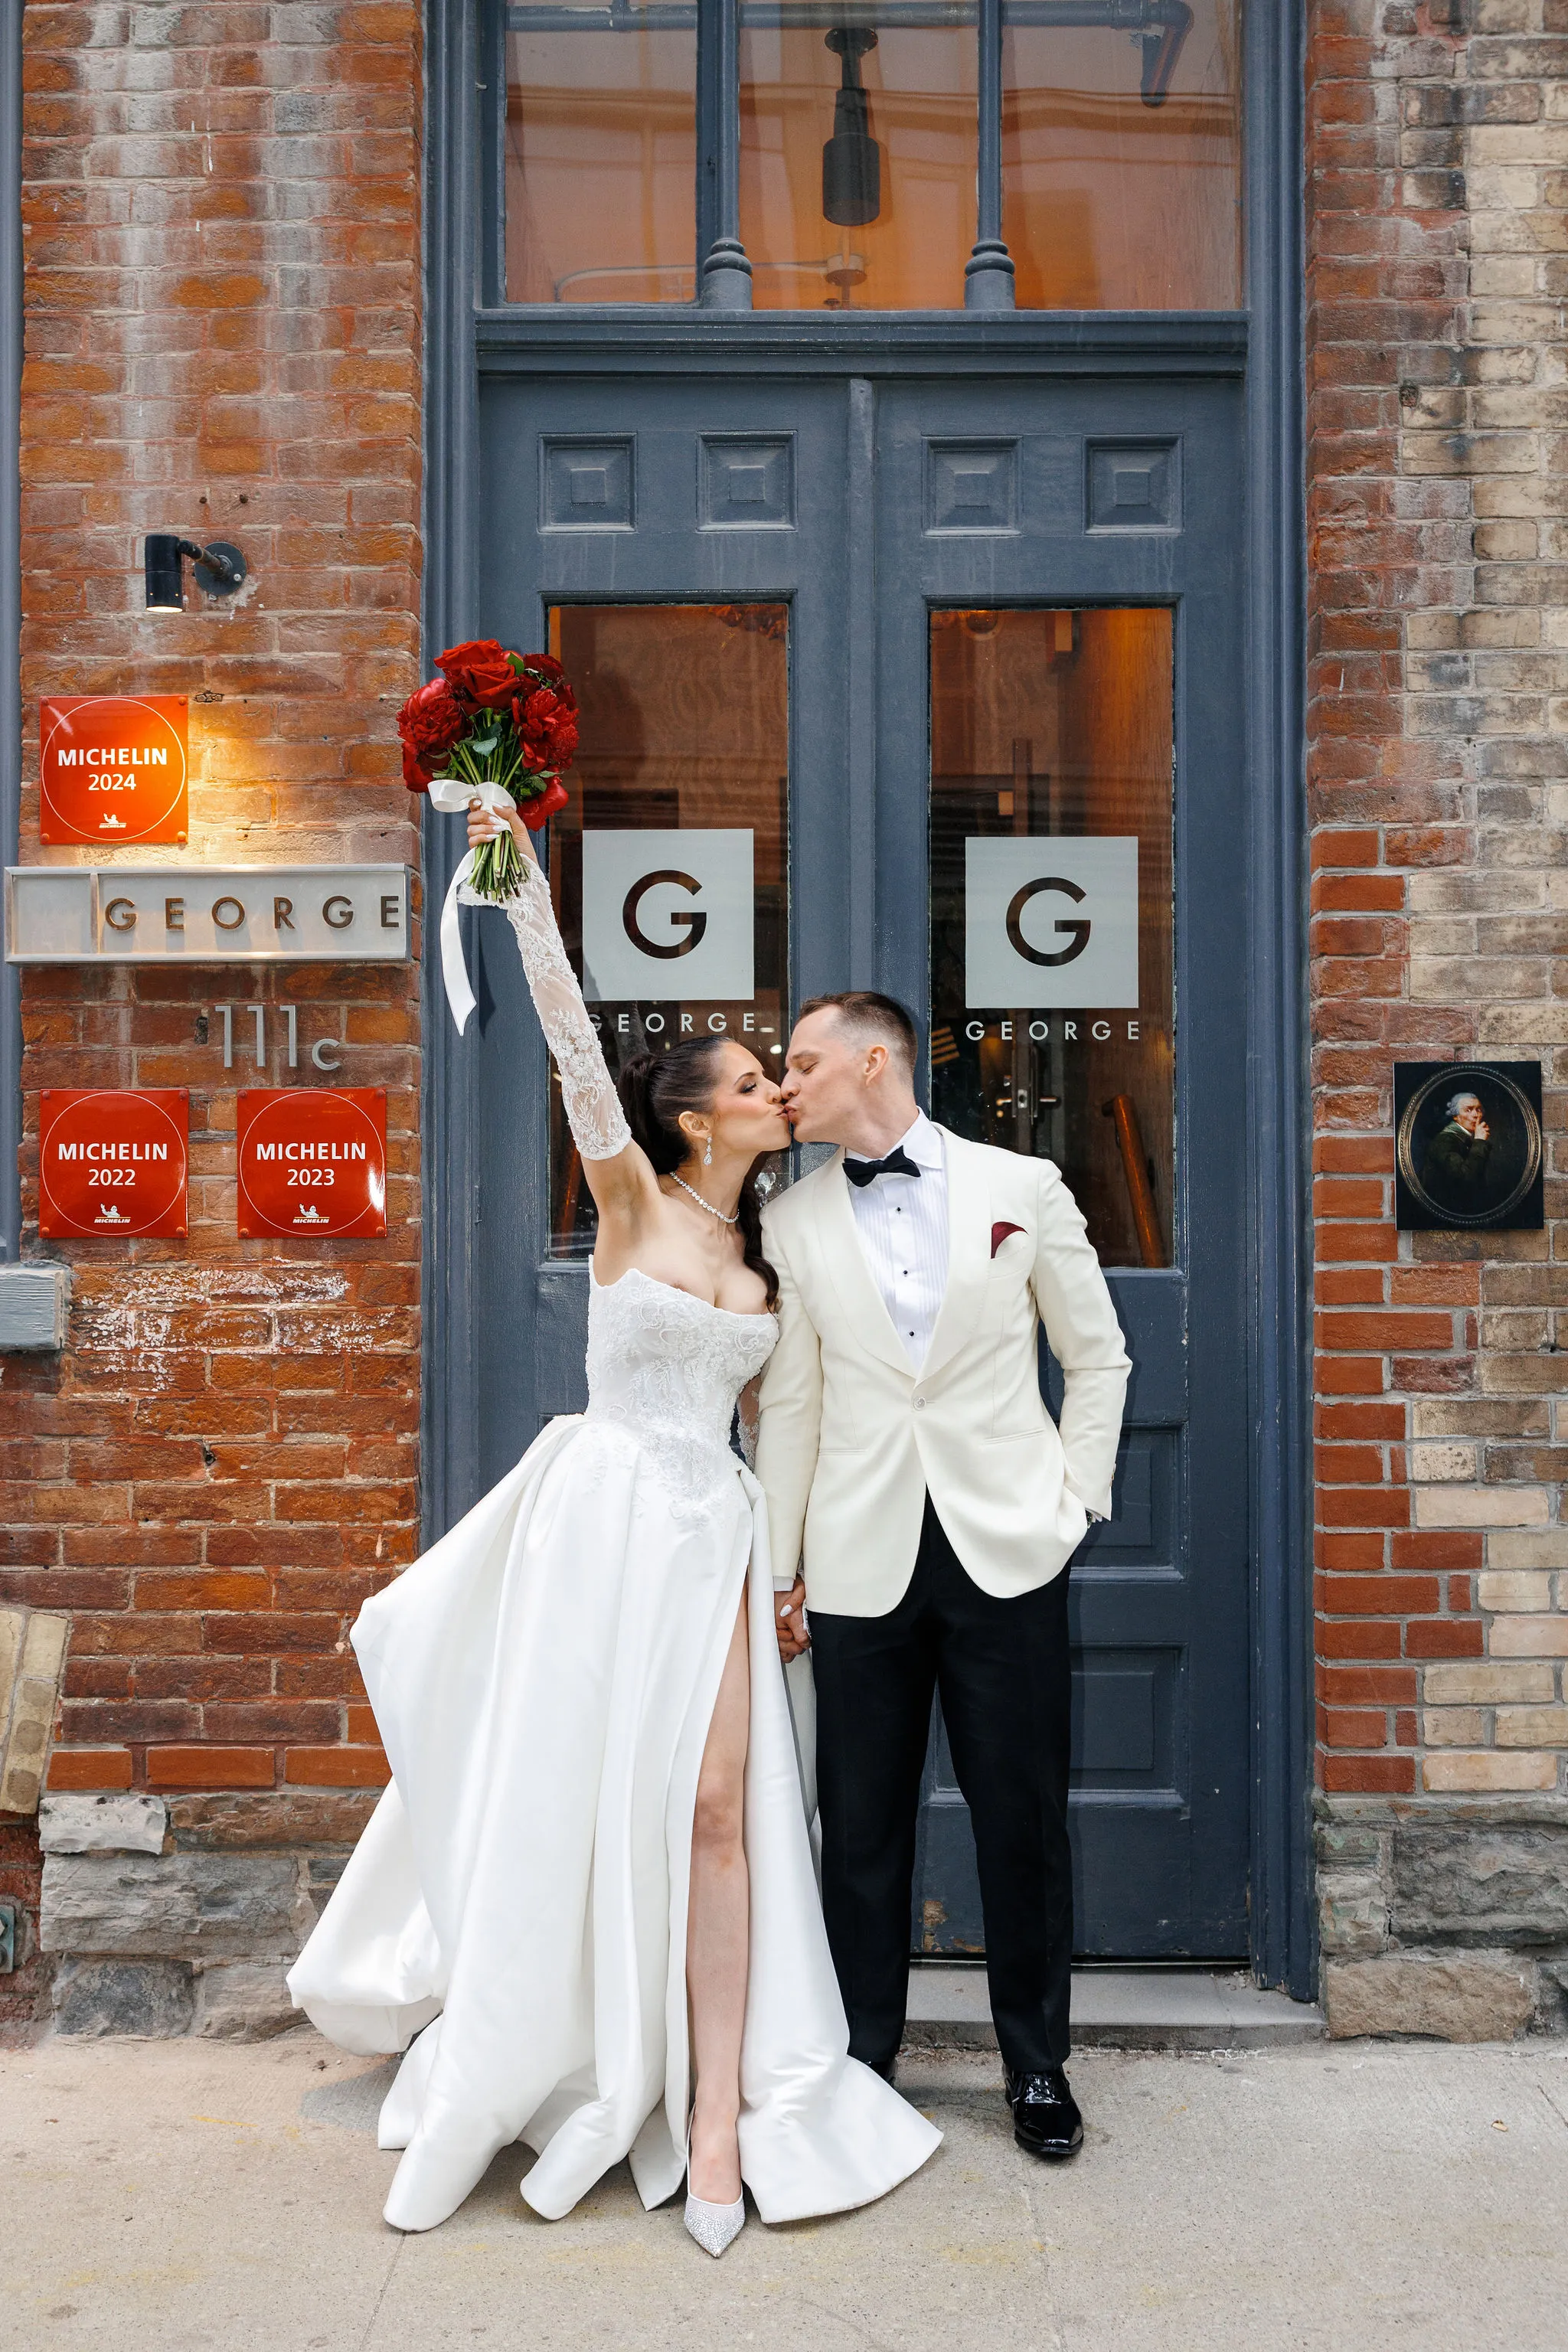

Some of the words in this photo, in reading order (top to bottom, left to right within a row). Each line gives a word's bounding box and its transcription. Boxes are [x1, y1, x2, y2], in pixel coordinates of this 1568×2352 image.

[58, 748, 167, 766] MICHELIN
[88, 773, 136, 791] 2024
[105, 895, 400, 931] GEORGE
[622, 870, 707, 959] G
[1006, 877, 1090, 967] G
[965, 1021, 1139, 1041] GEORGE
[58, 1143, 168, 1160] MICHELIN
[256, 1142, 366, 1161] MICHELIN
[88, 1169, 136, 1186] 2022
[287, 1169, 335, 1186] 2023
